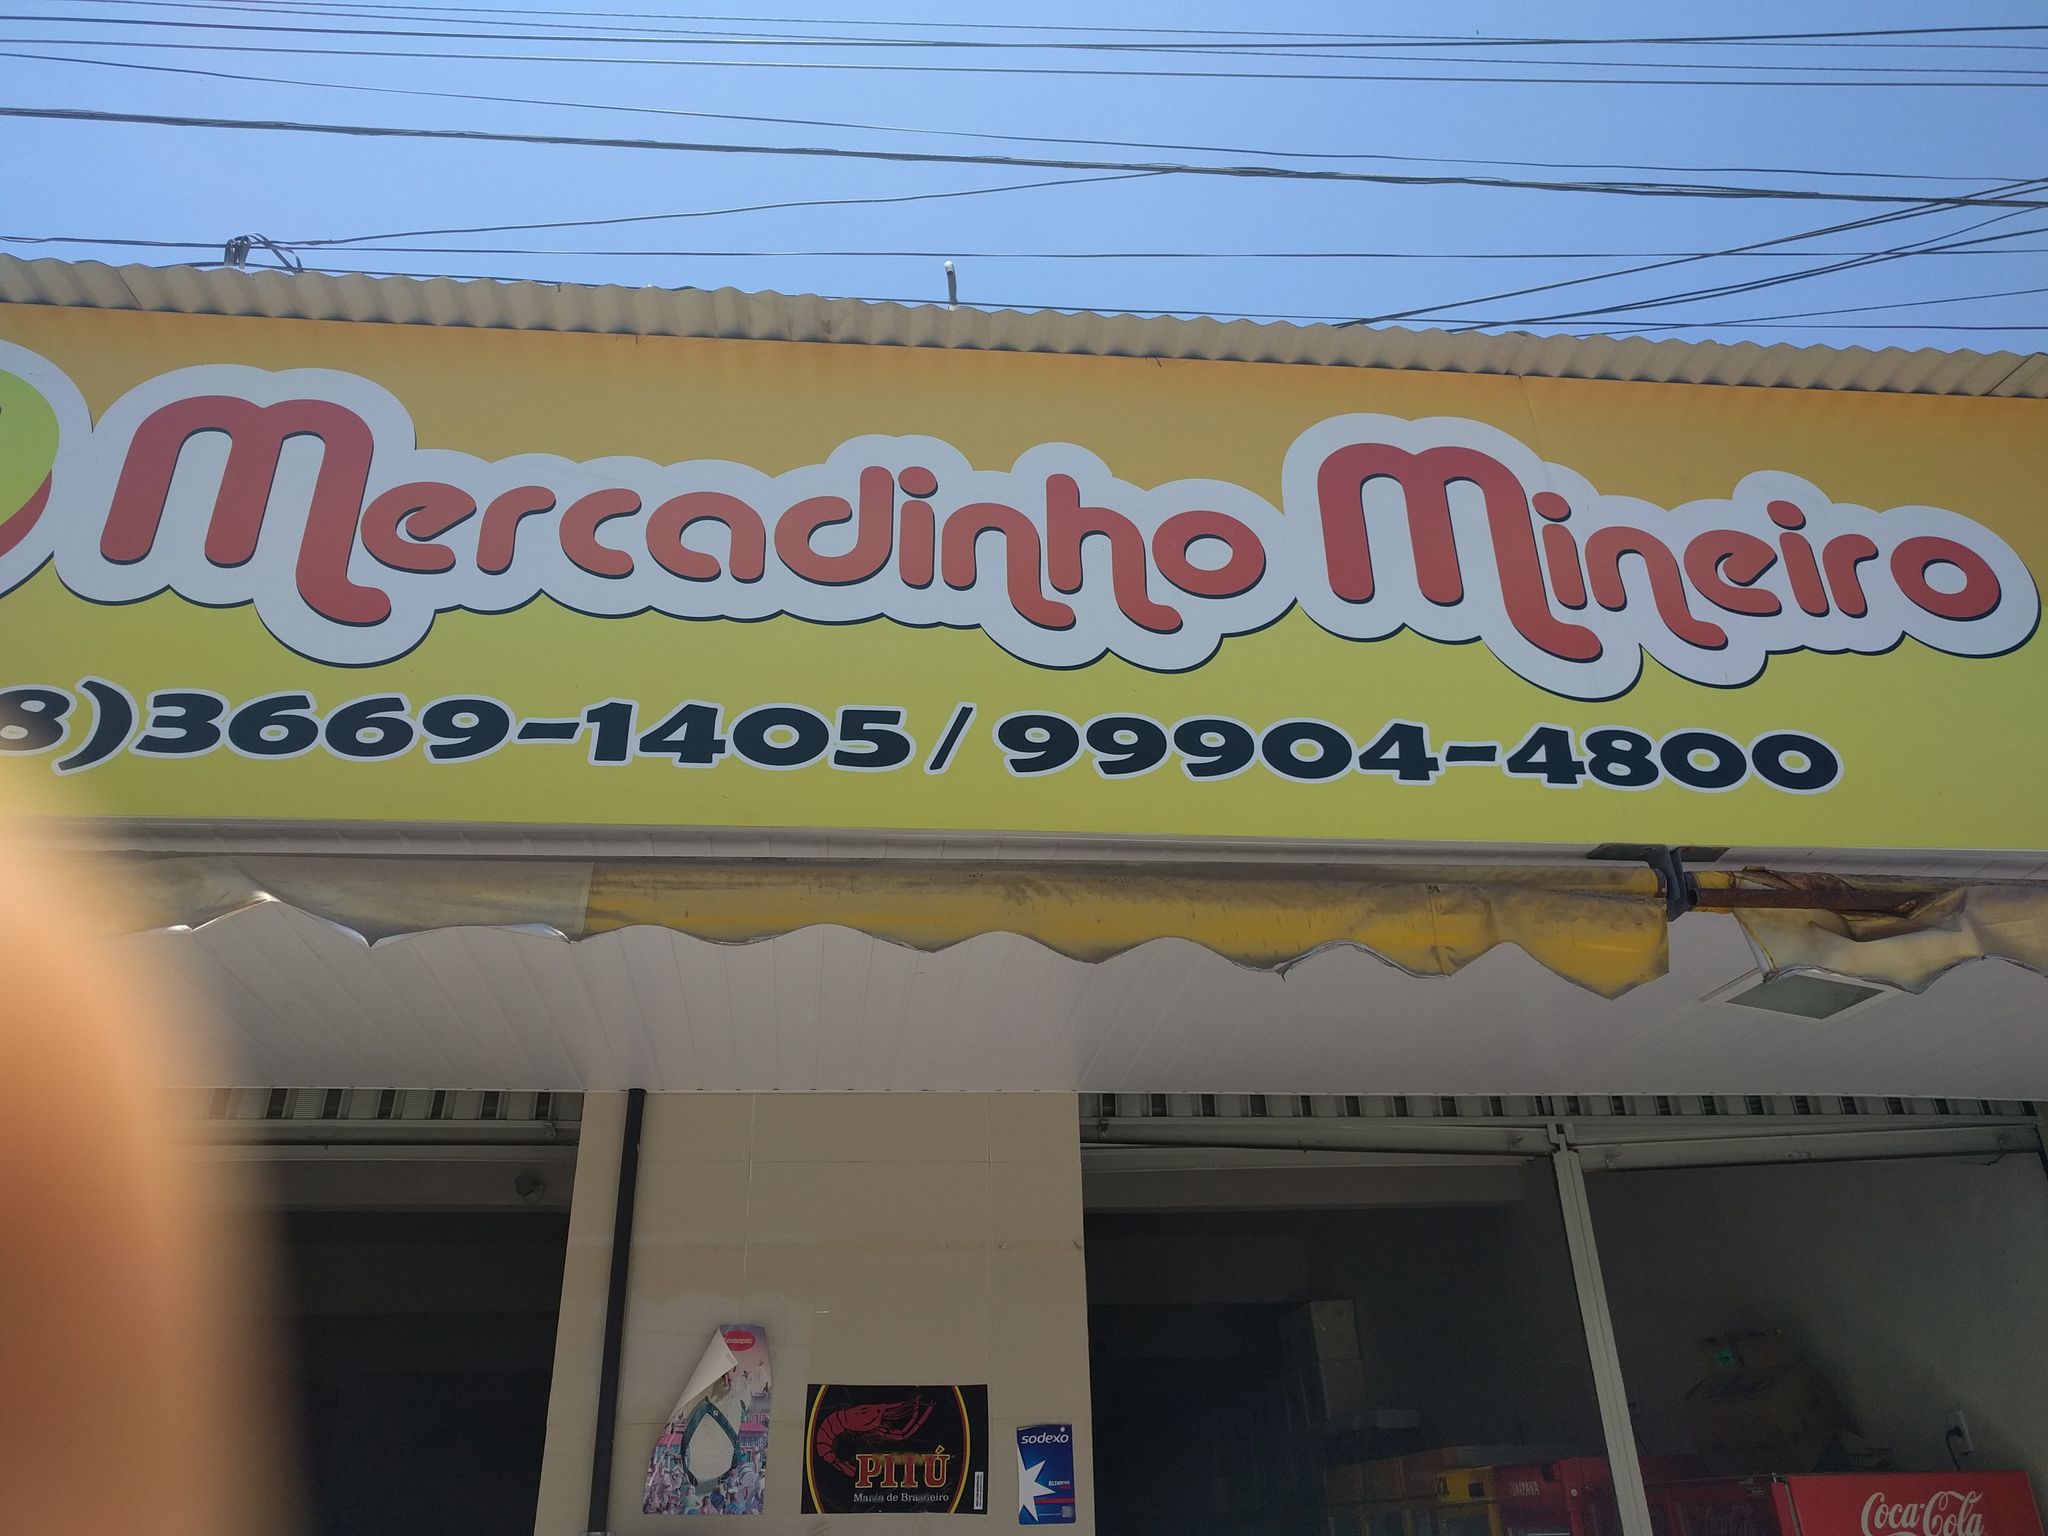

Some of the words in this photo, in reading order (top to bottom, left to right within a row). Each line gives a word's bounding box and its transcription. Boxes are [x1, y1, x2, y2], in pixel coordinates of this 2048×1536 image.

[100, 395, 1266, 633] Mercadinho
[1317, 442, 2001, 661] Mineiro
[1021, 1432, 1069, 1444] sodexo
[854, 1444, 951, 1488] PITÚ
[886, 1492, 900, 1502] de
[1860, 1488, 1986, 1536] Coca-Cola
